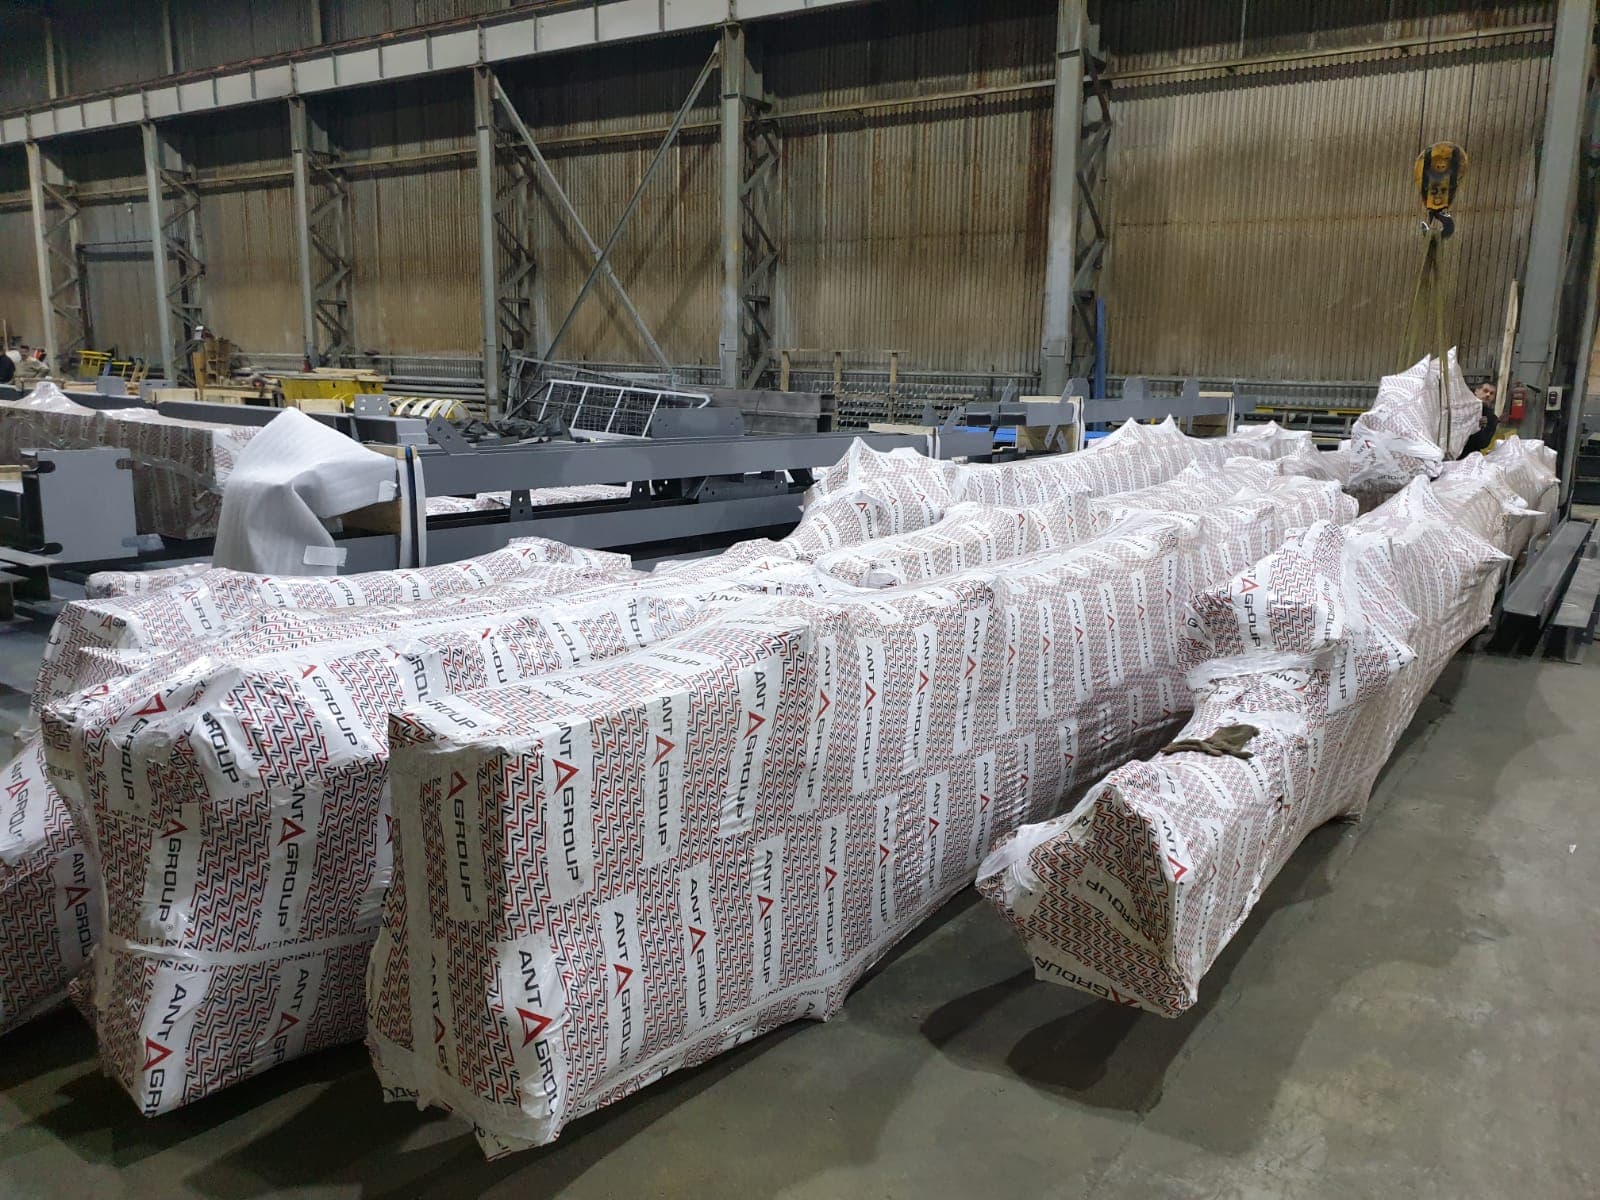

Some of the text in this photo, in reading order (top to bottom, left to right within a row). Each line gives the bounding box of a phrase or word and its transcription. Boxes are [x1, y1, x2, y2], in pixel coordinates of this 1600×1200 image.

[1072, 599, 1080, 625] ANT
[312, 676, 357, 746] GROUP
[862, 645, 875, 779] ANT GROUP
[962, 617, 980, 740] ANT GROUP
[1005, 663, 1013, 721] GROUP
[1270, 672, 1301, 684] ANT
[426, 699, 477, 729] ROUP
[737, 671, 765, 819] ANT GROUP
[913, 692, 925, 758] GROUP
[1064, 726, 1072, 751] ANT
[121, 718, 149, 800] GROUP
[658, 696, 672, 846] ANT GROUP
[807, 718, 825, 798] GROUP
[554, 721, 579, 880] ANT GROUP
[73, 853, 87, 884] ANT
[160, 838, 181, 922] GROUP
[277, 842, 299, 927] GROUP
[454, 799, 471, 902] GROUP
[762, 850, 773, 984] ANT GROUP
[826, 826, 837, 955] ANT GROUP
[880, 864, 888, 922] GROUP
[1086, 879, 1139, 931] GROUP
[614, 911, 629, 961] ANT
[690, 879, 707, 1018] ANT GROUP
[289, 969, 309, 1010] ANT
[519, 950, 542, 1007] ANT
[1035, 956, 1110, 1000] GROUP
[156, 984, 187, 1041] ANT
